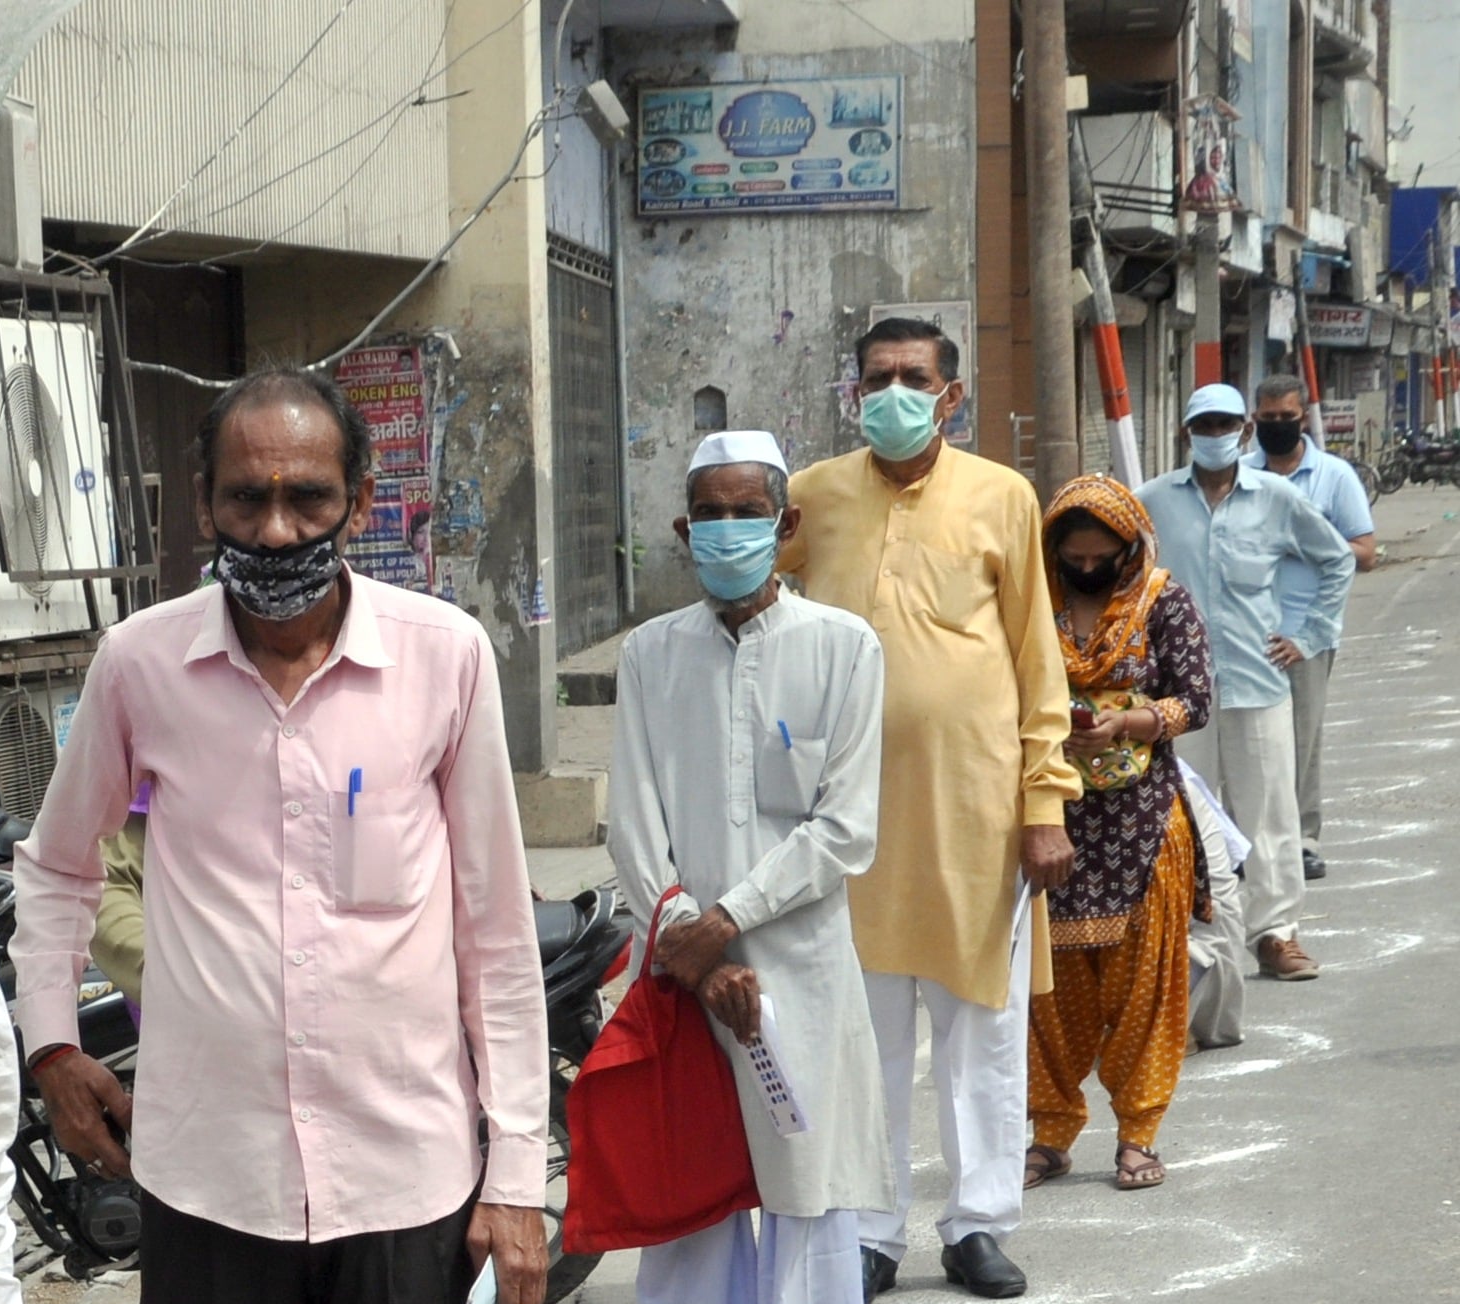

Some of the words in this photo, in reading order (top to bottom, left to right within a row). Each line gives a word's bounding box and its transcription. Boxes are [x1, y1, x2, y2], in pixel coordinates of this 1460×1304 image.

[722, 119, 752, 138] J.J.
[758, 116, 812, 136] FARM
[349, 385, 387, 402] OKEN
[391, 384, 421, 399] ENG
